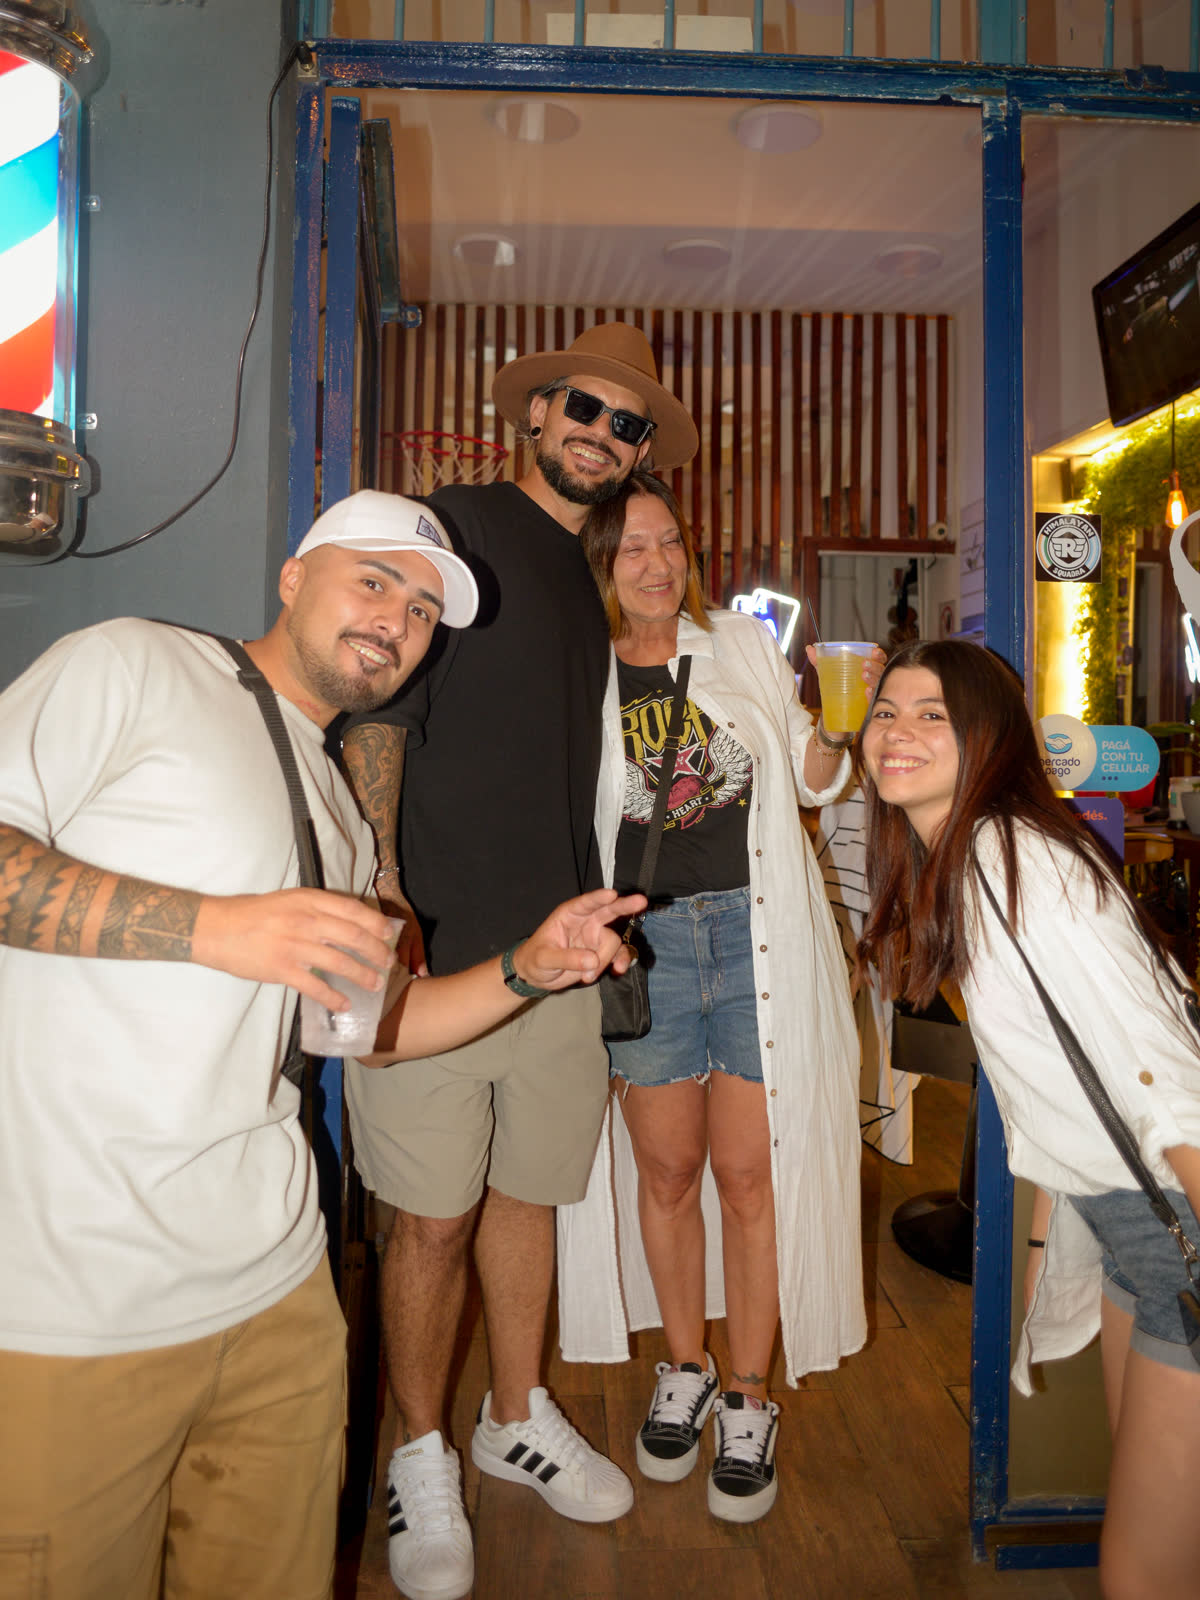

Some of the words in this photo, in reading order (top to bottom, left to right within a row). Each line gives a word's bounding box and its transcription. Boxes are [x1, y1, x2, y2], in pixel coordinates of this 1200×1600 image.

[1044, 518, 1095, 537] HIMALAYAN
[1053, 567, 1085, 578] SQUADRA
[1102, 739, 1131, 750] PAGÁ
[1102, 752, 1126, 761] CON
[1128, 752, 1144, 761] TU
[1045, 767, 1071, 778] pago
[1102, 763, 1150, 773] CELULAR
[671, 796, 703, 819] HEART
[1073, 810, 1107, 821] odés.
